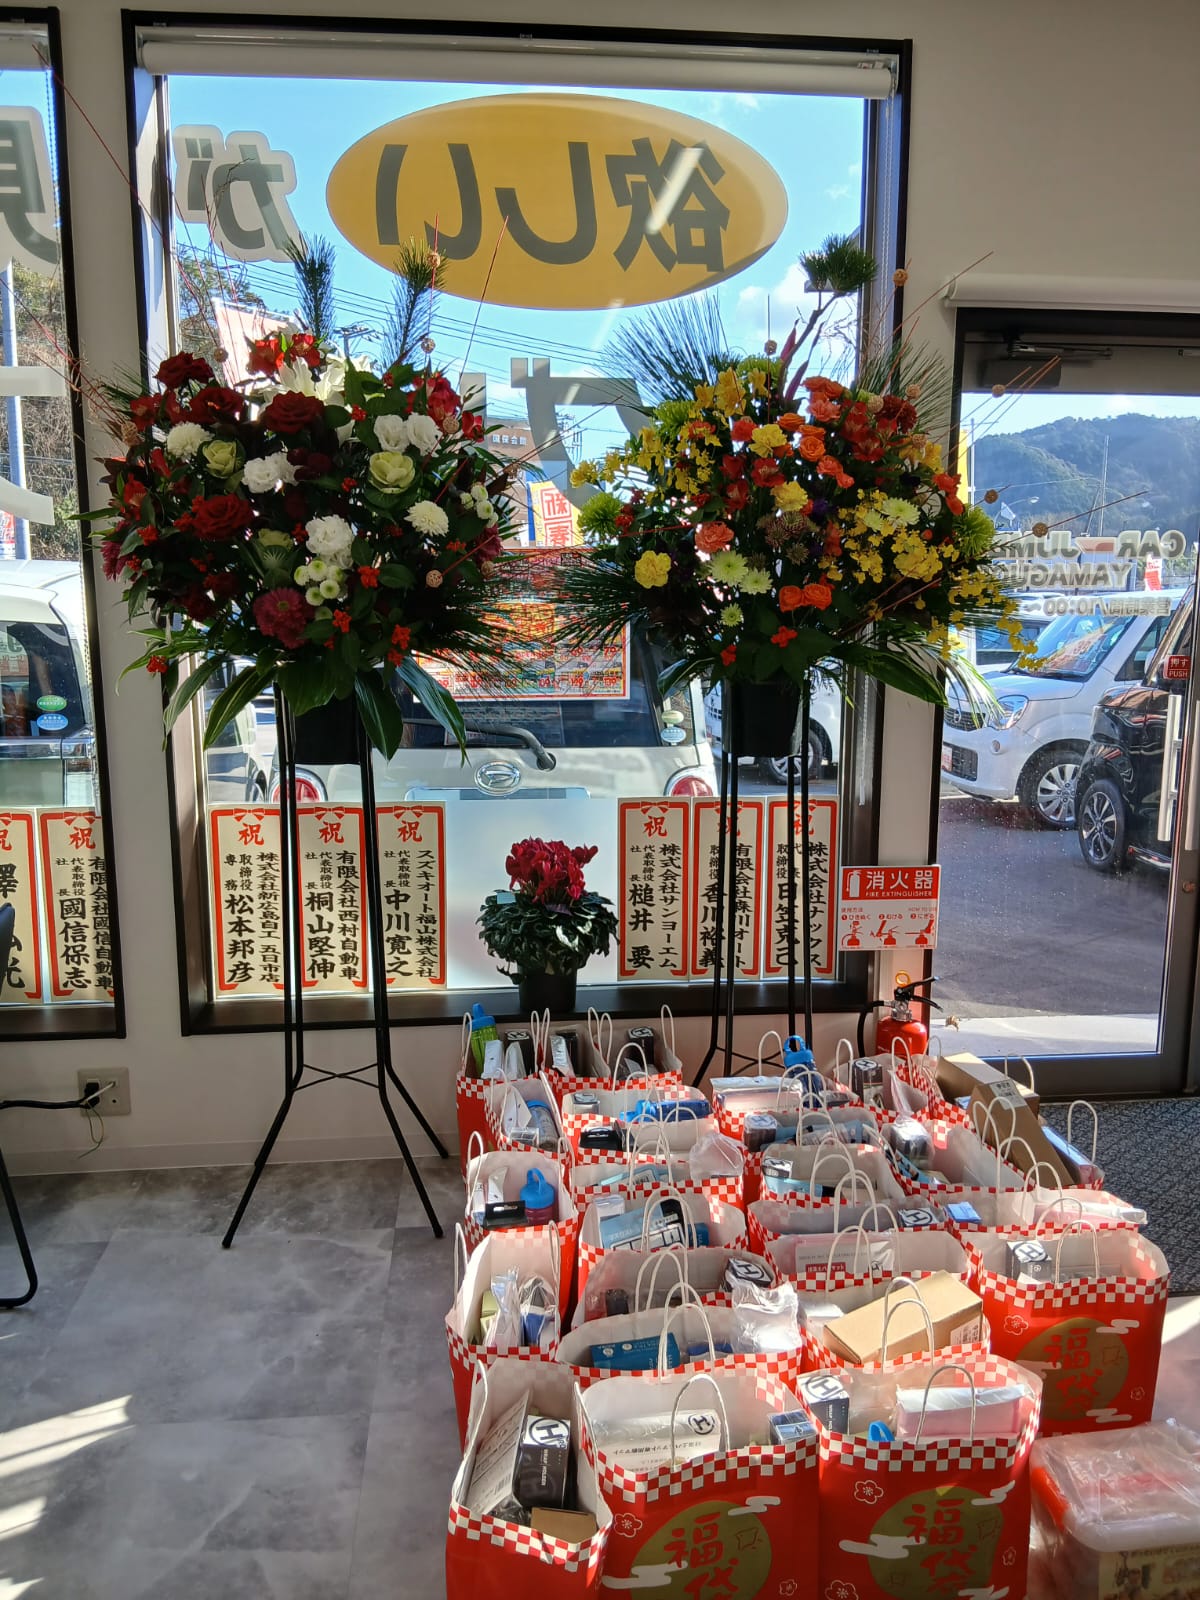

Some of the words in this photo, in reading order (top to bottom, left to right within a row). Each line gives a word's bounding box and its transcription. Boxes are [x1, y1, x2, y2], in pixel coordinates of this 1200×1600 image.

[1170, 658, 1188, 668] 押す
[238, 822, 265, 846] 祝
[318, 821, 344, 844] 祝
[397, 820, 423, 843] 祝
[643, 815, 668, 837] 祝
[793, 814, 815, 836] 祝
[69, 826, 96, 850] 祝
[239, 853, 253, 892] 取締役
[866, 869, 934, 890] 消火器
[336, 850, 361, 981] 有限会社西村自動車
[658, 843, 682, 969] 株式会社サンヨーエム
